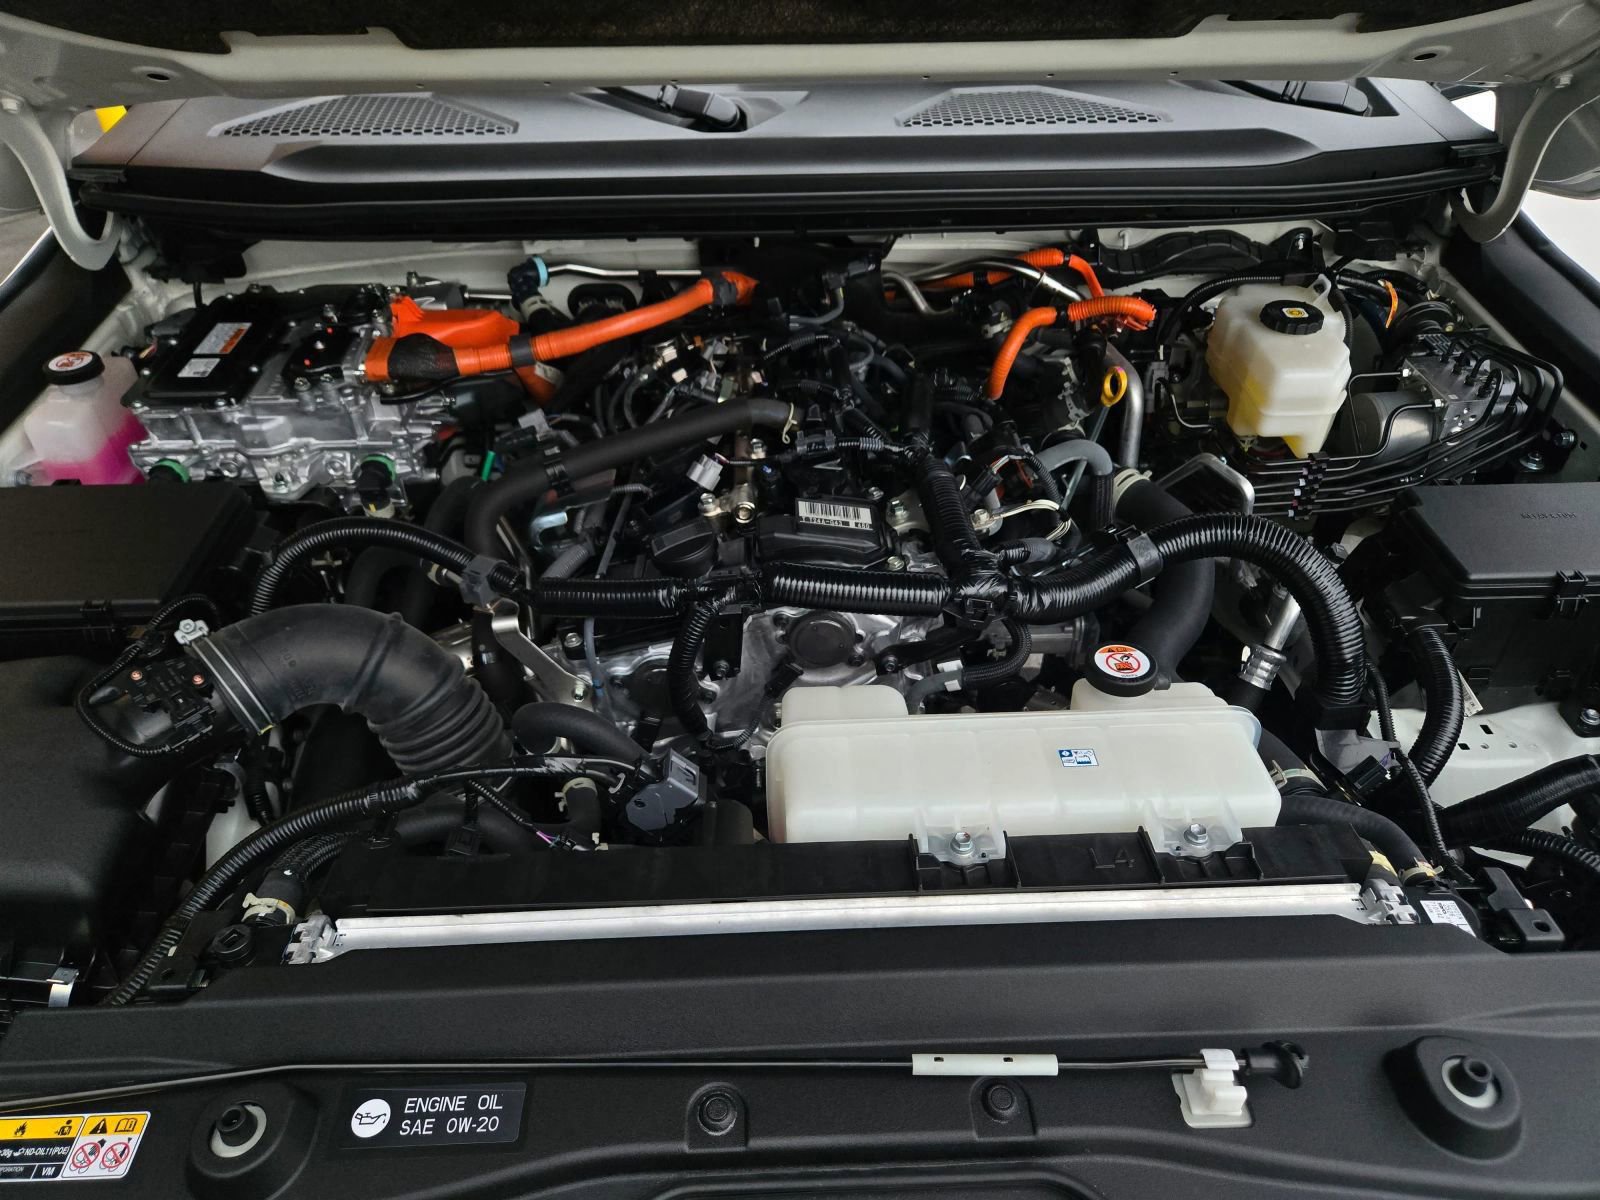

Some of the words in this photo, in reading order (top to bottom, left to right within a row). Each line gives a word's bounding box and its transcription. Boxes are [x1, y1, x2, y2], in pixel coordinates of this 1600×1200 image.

[404, 1096, 467, 1114] ENGINE
[477, 1094, 504, 1110] OIL
[399, 1118, 435, 1136] SAE
[446, 1116, 500, 1134] 0W-20
